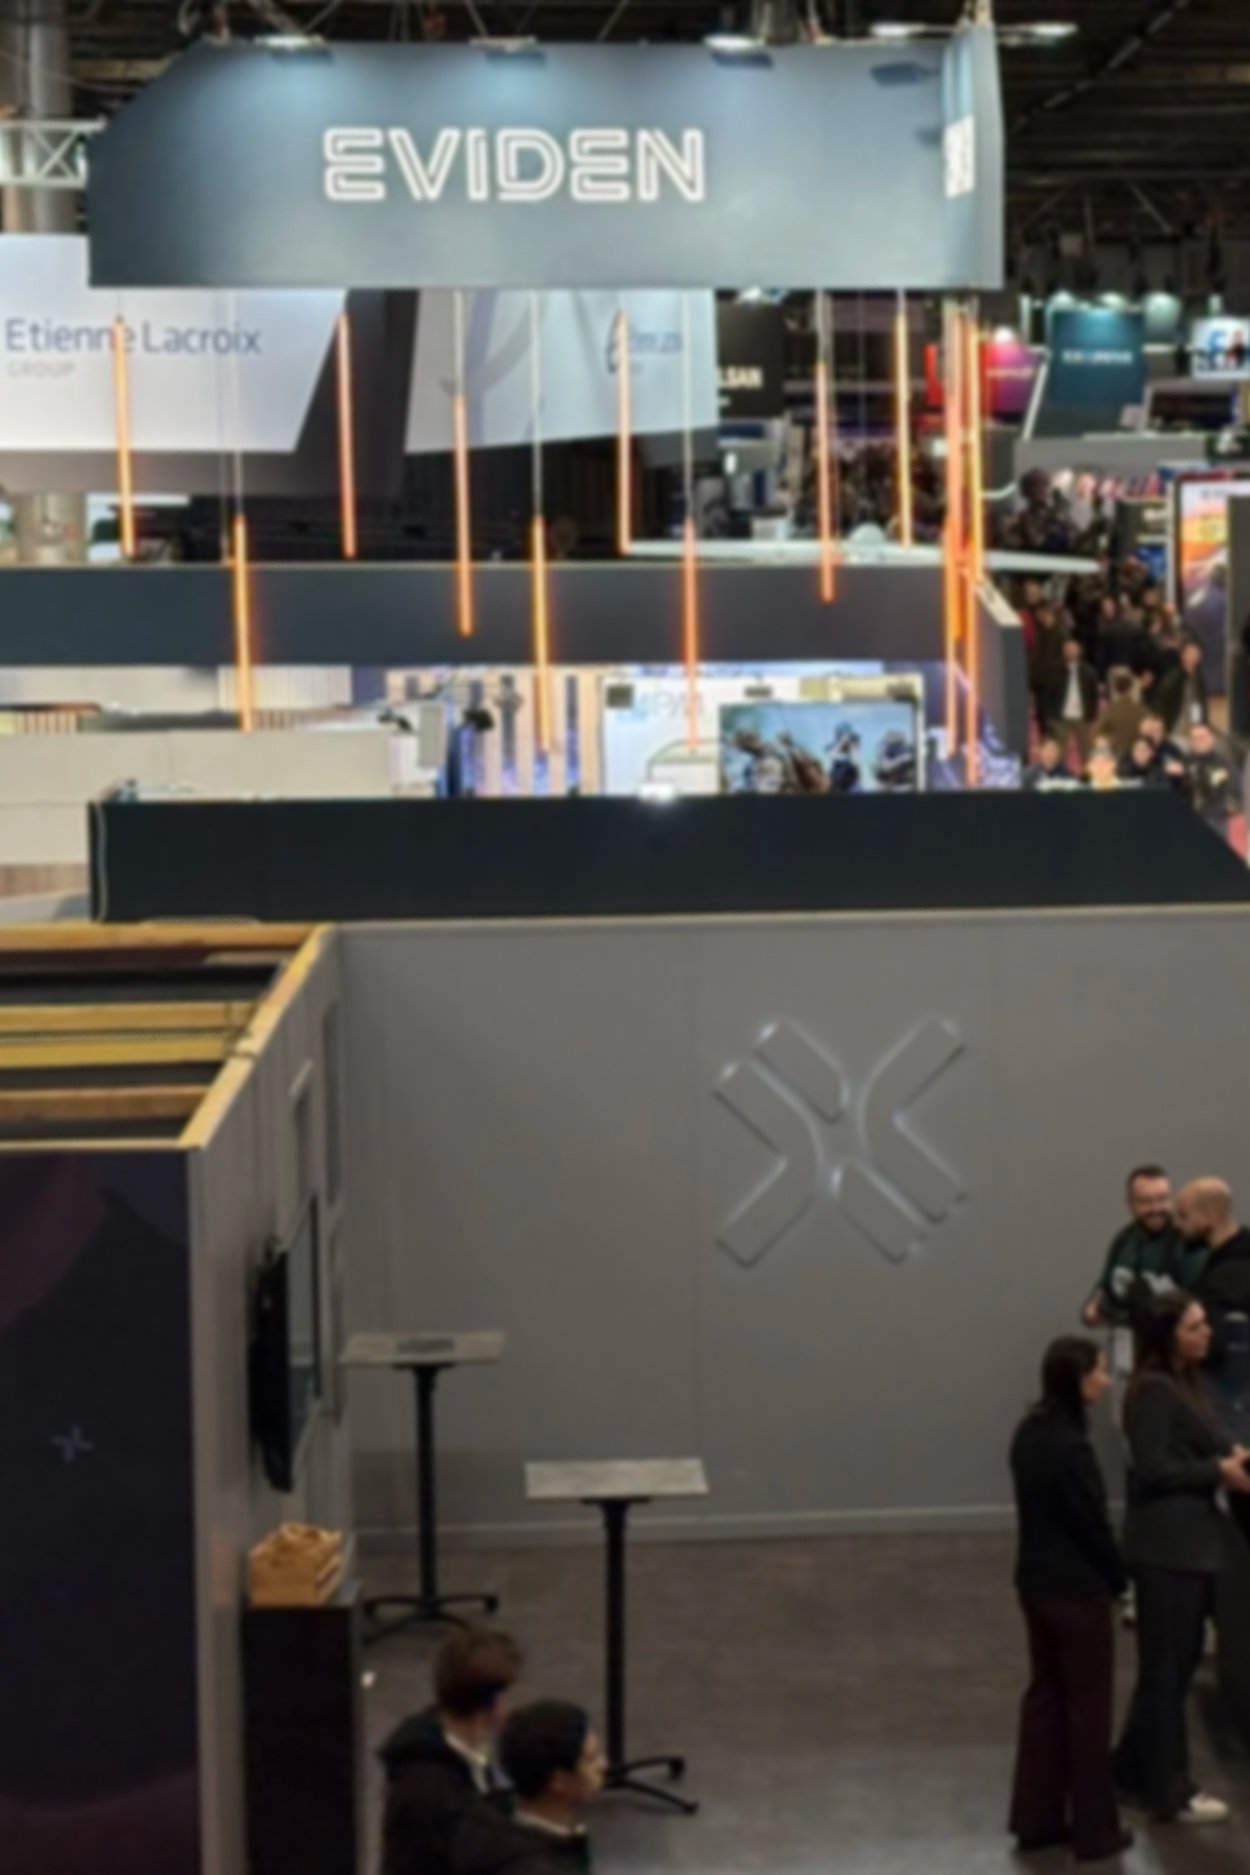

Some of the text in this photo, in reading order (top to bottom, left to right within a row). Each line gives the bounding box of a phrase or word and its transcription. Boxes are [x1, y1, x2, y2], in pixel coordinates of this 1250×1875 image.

[324, 128, 704, 202] EVIDEN
[5, 318, 262, 354] Etienne Lacroix
